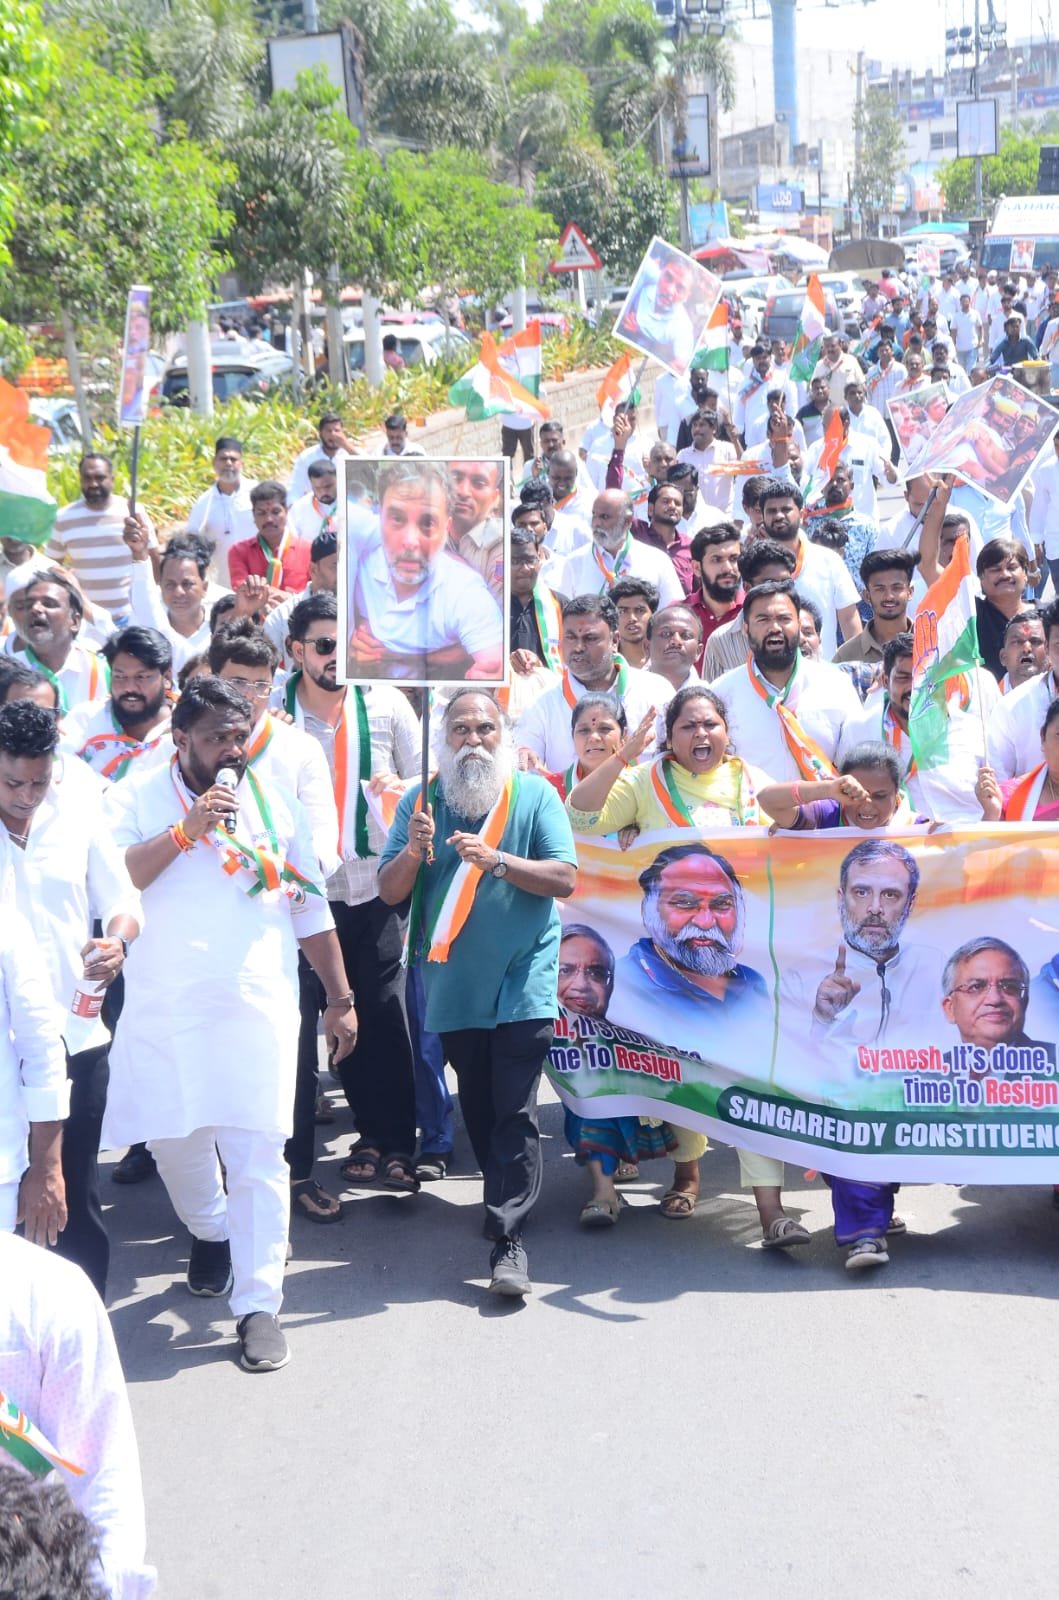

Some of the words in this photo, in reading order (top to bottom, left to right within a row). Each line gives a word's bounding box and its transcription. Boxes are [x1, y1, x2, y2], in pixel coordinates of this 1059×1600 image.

[1002, 201, 1059, 210] SAHAR
[548, 1047, 581, 1071] me
[585, 1043, 611, 1068] To
[614, 1045, 682, 1082] Resign
[857, 1045, 949, 1073] Gyanesh,
[953, 1045, 987, 1071] It's
[992, 1045, 1053, 1073] done,
[903, 1077, 951, 1104] Time
[956, 1078, 980, 1104] To
[985, 1078, 1058, 1108] Resign
[728, 1095, 887, 1147] SANGAREDDY
